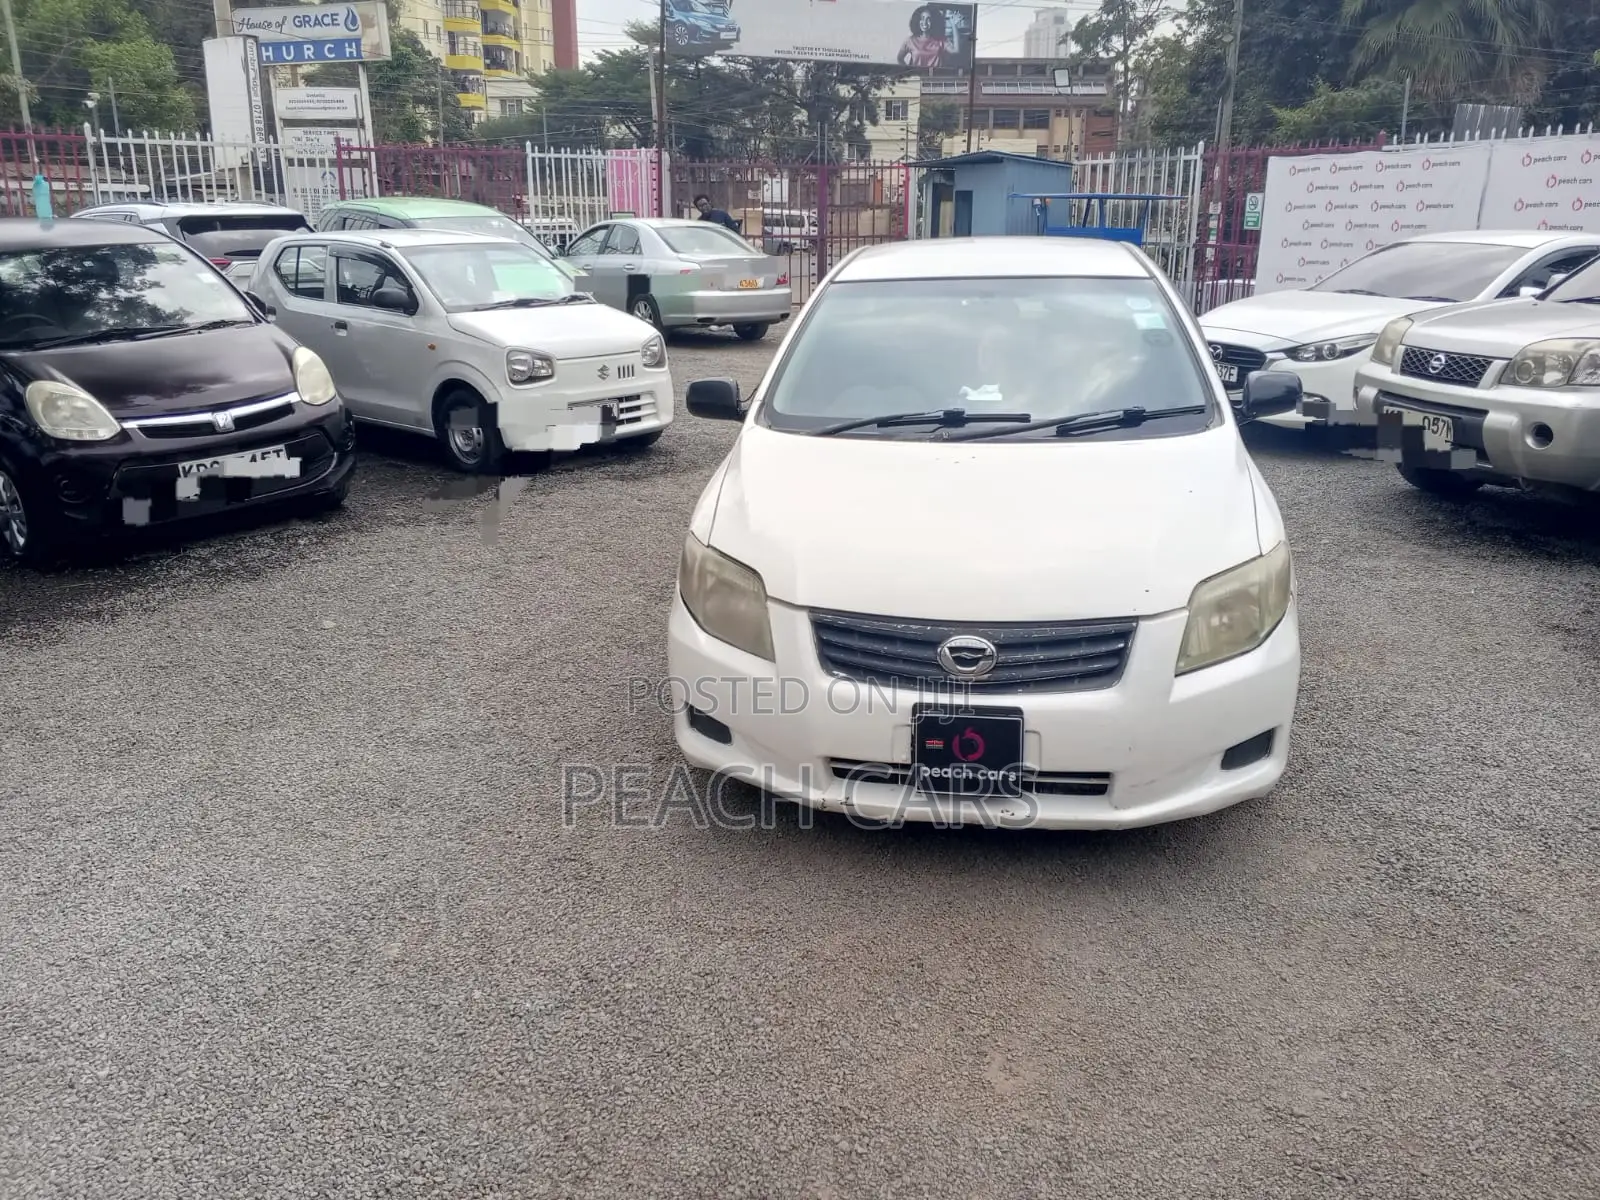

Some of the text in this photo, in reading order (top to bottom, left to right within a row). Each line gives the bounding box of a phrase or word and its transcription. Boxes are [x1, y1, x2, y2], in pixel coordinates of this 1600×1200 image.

[239, 13, 340, 33] House of GRACE
[261, 41, 357, 61] HURCH
[1533, 155, 1552, 164] peach
[1557, 176, 1578, 186] peach
[1525, 201, 1544, 209] peach
[919, 763, 1018, 782] peach cars
